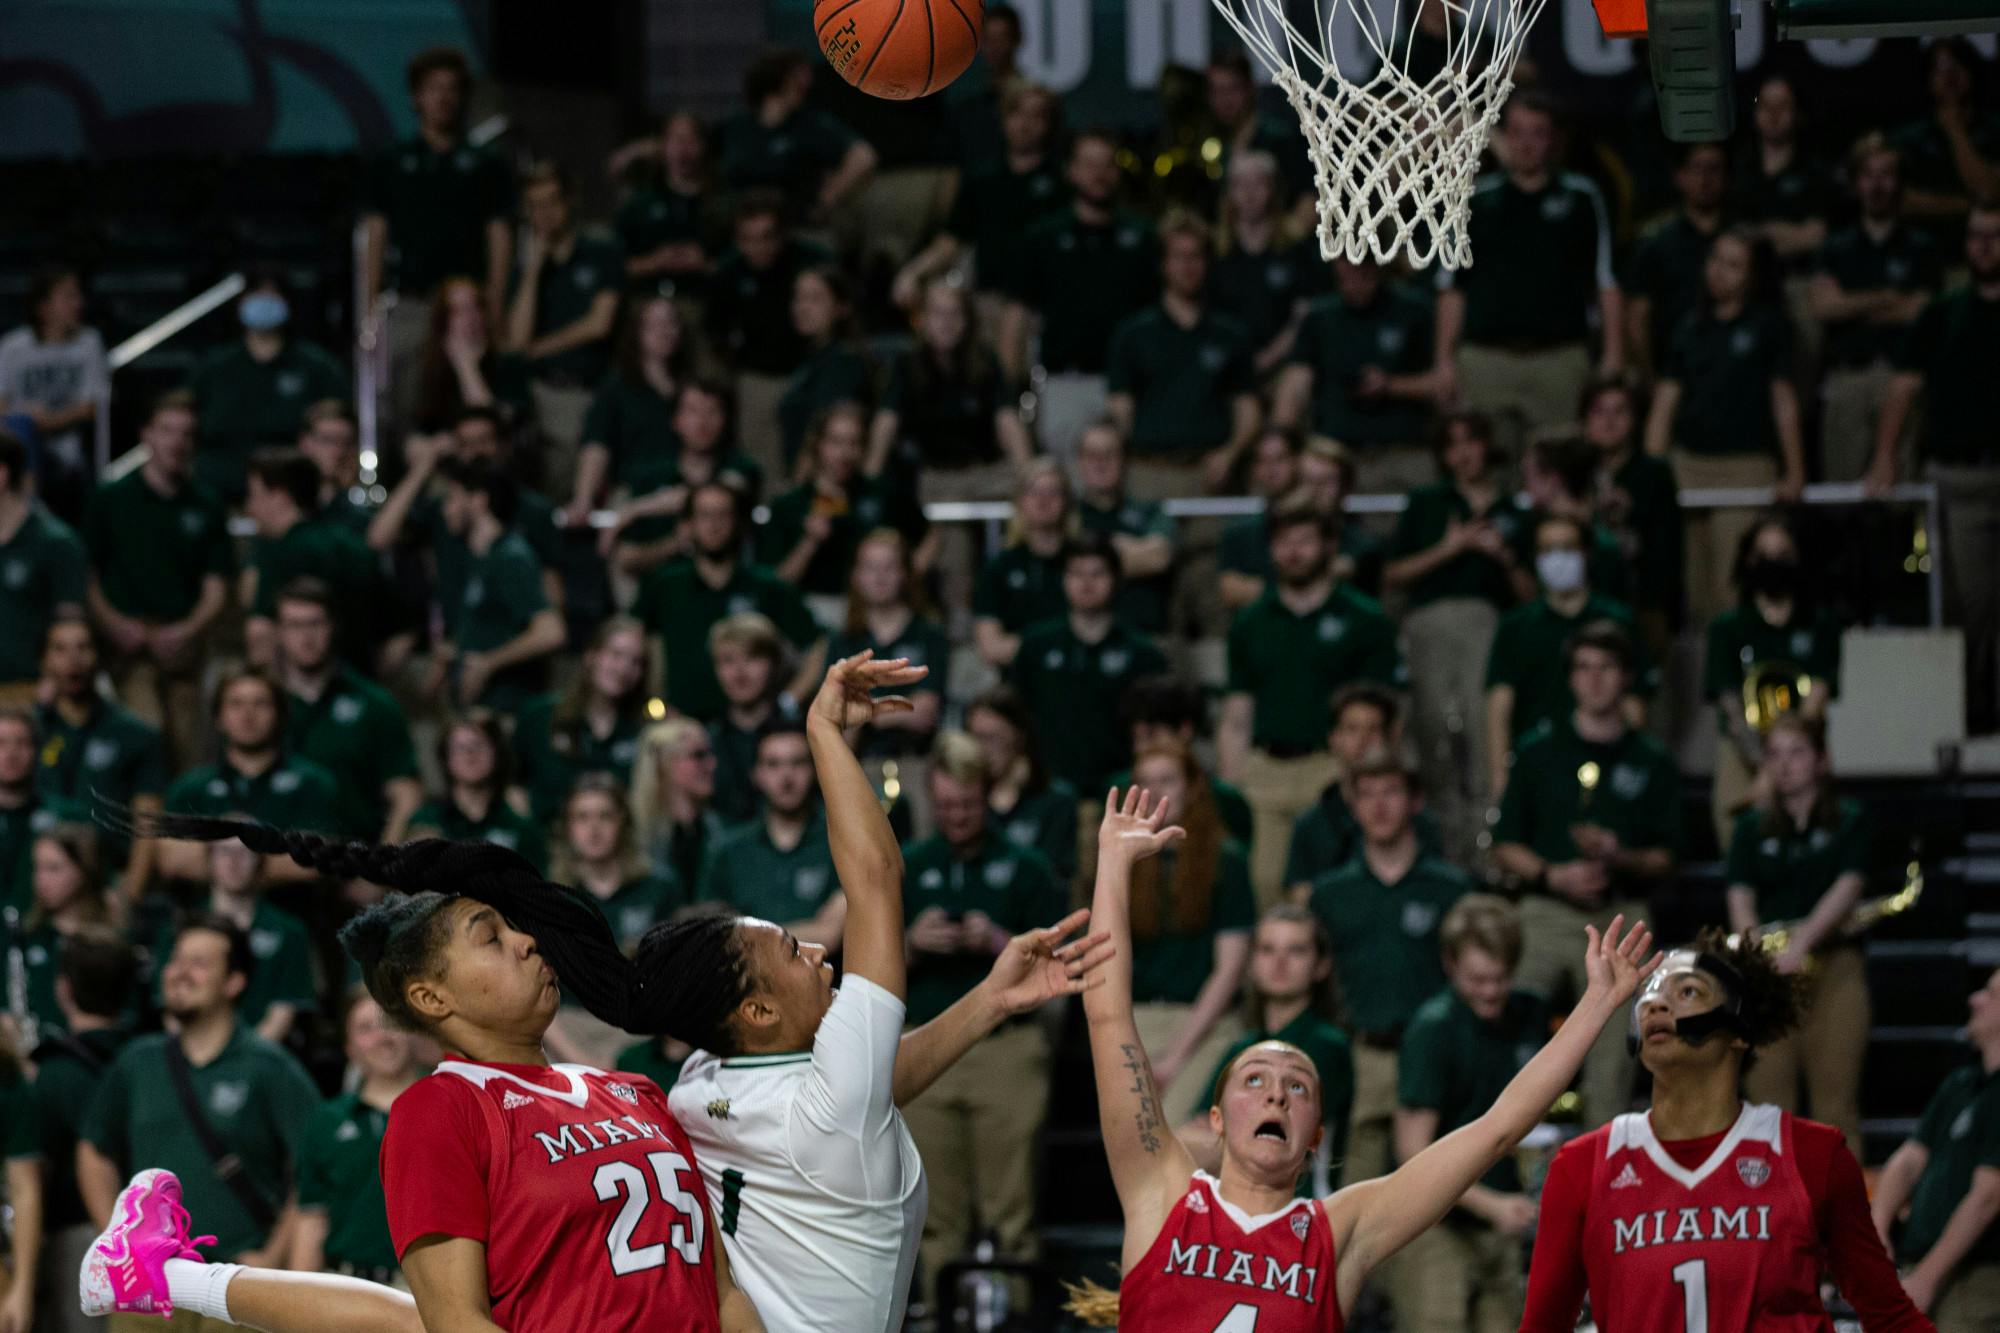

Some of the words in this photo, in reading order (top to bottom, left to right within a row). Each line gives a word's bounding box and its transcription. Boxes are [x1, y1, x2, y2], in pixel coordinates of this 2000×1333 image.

[592, 1151, 705, 1277] 25
[1613, 1205, 1772, 1254] MIAMI
[1164, 1237, 1317, 1304] MIAMI
[1672, 1258, 1709, 1333] 1
